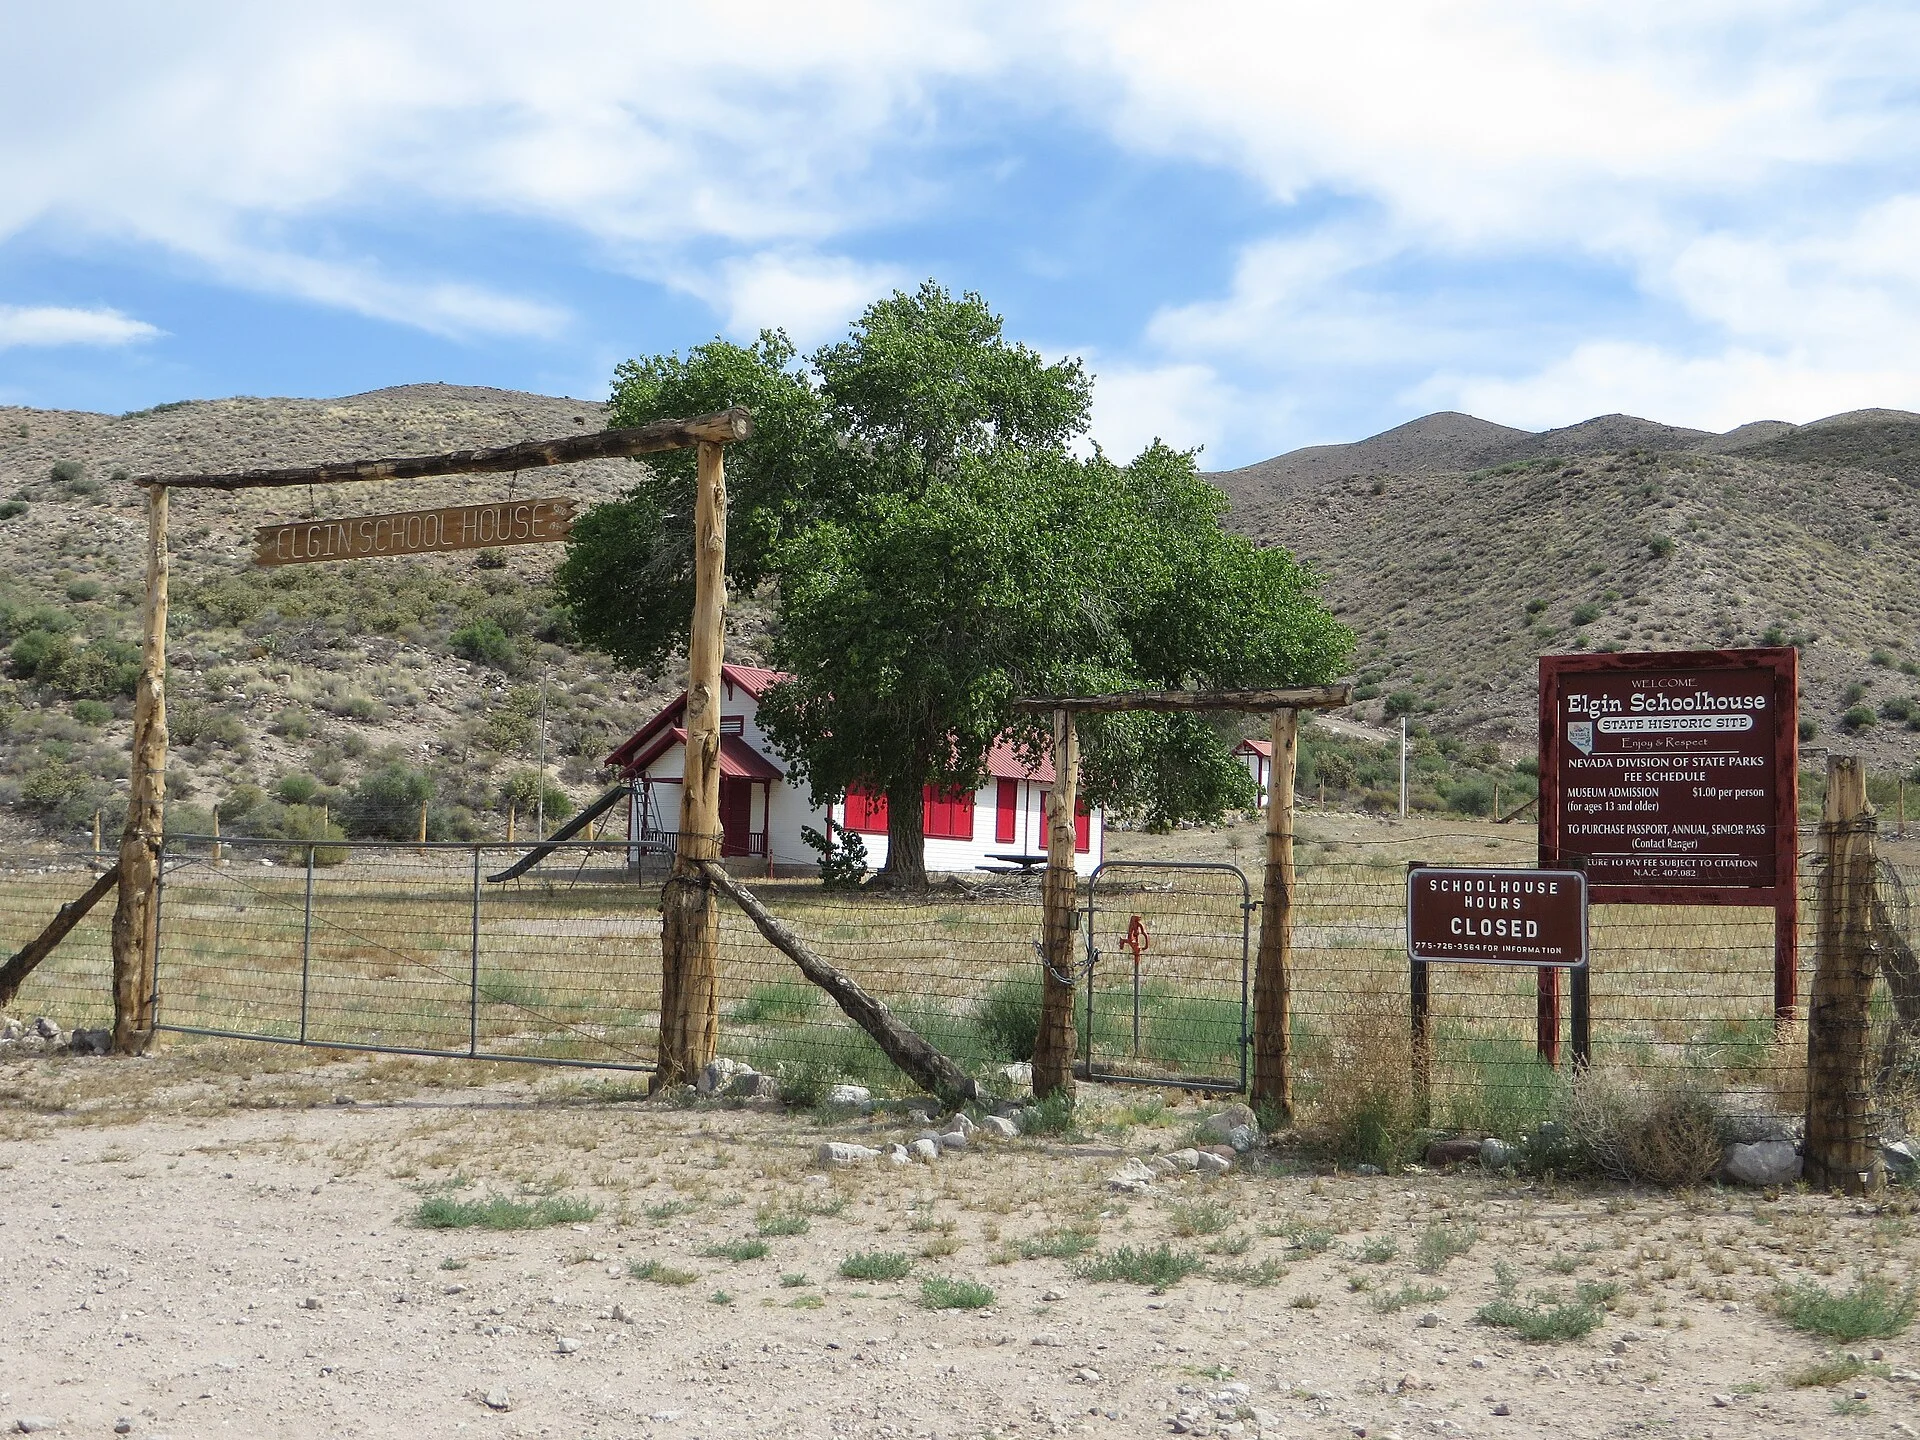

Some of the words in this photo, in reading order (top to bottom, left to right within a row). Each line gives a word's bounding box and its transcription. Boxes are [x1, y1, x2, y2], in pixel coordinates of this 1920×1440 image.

[277, 522, 353, 560] ELGIN
[359, 514, 453, 553] SCHOOL
[462, 503, 547, 543] HOUSE
[1632, 678, 1698, 688] WELCOME
[1567, 694, 1622, 719] Elgin
[1630, 691, 1766, 712] Schoolhouse
[1602, 719, 1644, 730] STATE
[1648, 718, 1712, 729] HISTORIC
[1716, 717, 1747, 728] SITE
[1622, 738, 1653, 751] Enjoy
[1656, 739, 1664, 747] &
[1665, 737, 1708, 750] Respect
[1568, 758, 1613, 768] NEVADA
[1616, 757, 1670, 768] DIVISION
[1673, 757, 1689, 767] OF
[1692, 757, 1725, 767] STATE
[1728, 756, 1764, 767] PARKS
[1624, 772, 1642, 782] FEE
[1645, 771, 1706, 782] SCHEDULE
[1567, 788, 1606, 798] MUSEUM
[1608, 787, 1659, 798] ADMISSION
[1692, 787, 1716, 798] $1.00
[1718, 789, 1732, 800] per
[1735, 789, 1764, 800] person
[1567, 801, 1582, 812] (for
[1583, 804, 1602, 814] ages
[1604, 802, 1615, 811] 13
[1617, 801, 1633, 811] and
[1634, 801, 1659, 812] older)
[1567, 825, 1580, 834] TO
[1581, 824, 1625, 835] PURCHASE
[1627, 824, 1670, 836] PASSPORT,
[1672, 824, 1709, 836] ANNUAL,
[1711, 824, 1743, 835] SENIOR
[1746, 824, 1766, 835] PASS
[1632, 838, 1665, 849] (Contact
[1667, 838, 1698, 851] Ranger)
[1587, 859, 1608, 867] LURE
[1612, 859, 1623, 867] TO
[1625, 859, 1641, 867] PAY
[1643, 859, 1657, 867] FEE
[1659, 859, 1696, 868] SUBJECT
[1700, 859, 1711, 868] TO
[1714, 859, 1758, 868] CITATION
[1633, 869, 1660, 877] N.A.C.
[1662, 869, 1696, 877] 407.082
[1429, 879, 1558, 895] SCHOOLHOUSE
[1464, 895, 1521, 910] HOURS
[1451, 917, 1538, 938] CLOSED
[1415, 942, 1481, 951] 775-726-3564
[1482, 944, 1499, 952] FOR
[1502, 945, 1562, 955] INFORMATION
